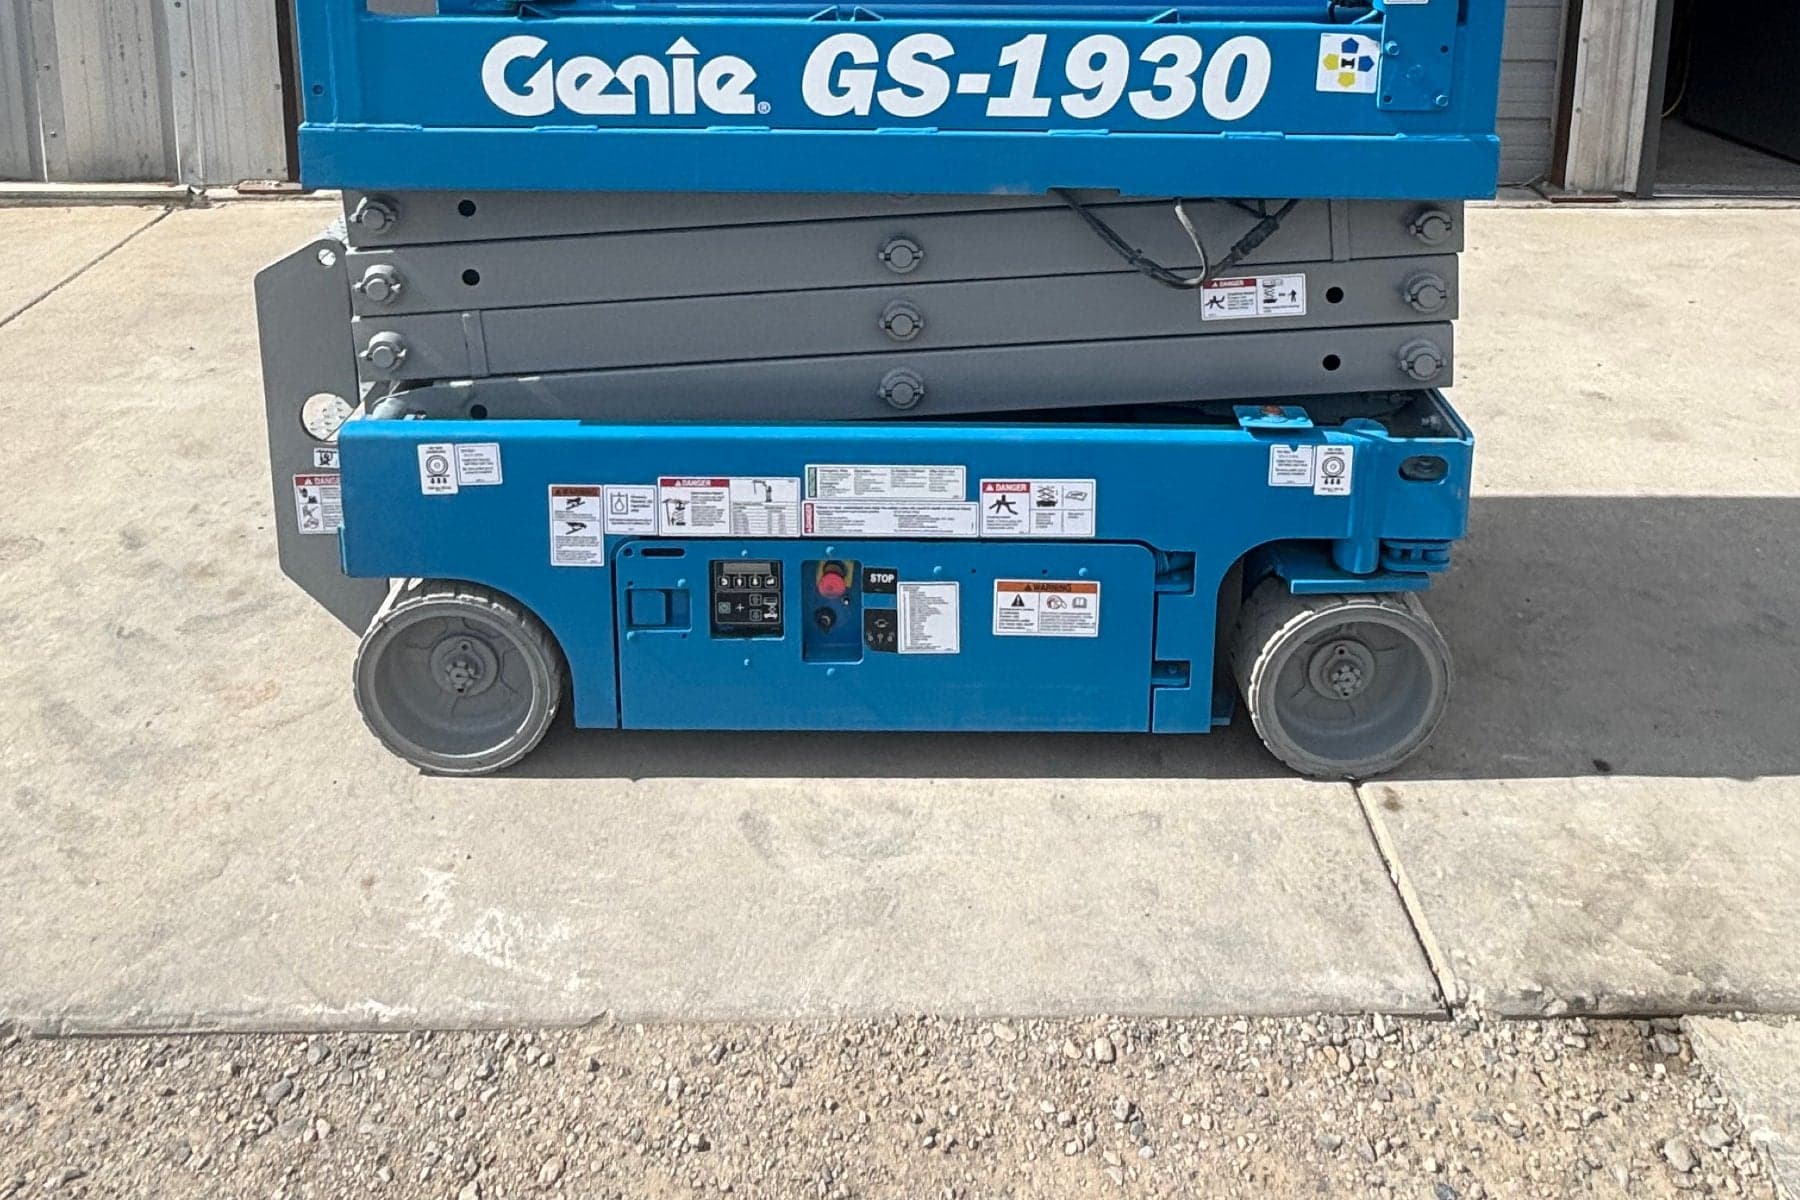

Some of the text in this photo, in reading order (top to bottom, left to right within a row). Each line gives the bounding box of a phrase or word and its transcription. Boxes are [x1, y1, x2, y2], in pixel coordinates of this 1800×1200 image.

[802, 31, 1272, 120] GS-1930
[995, 482, 1027, 492] DANGER
[870, 573, 895, 584] STOP
